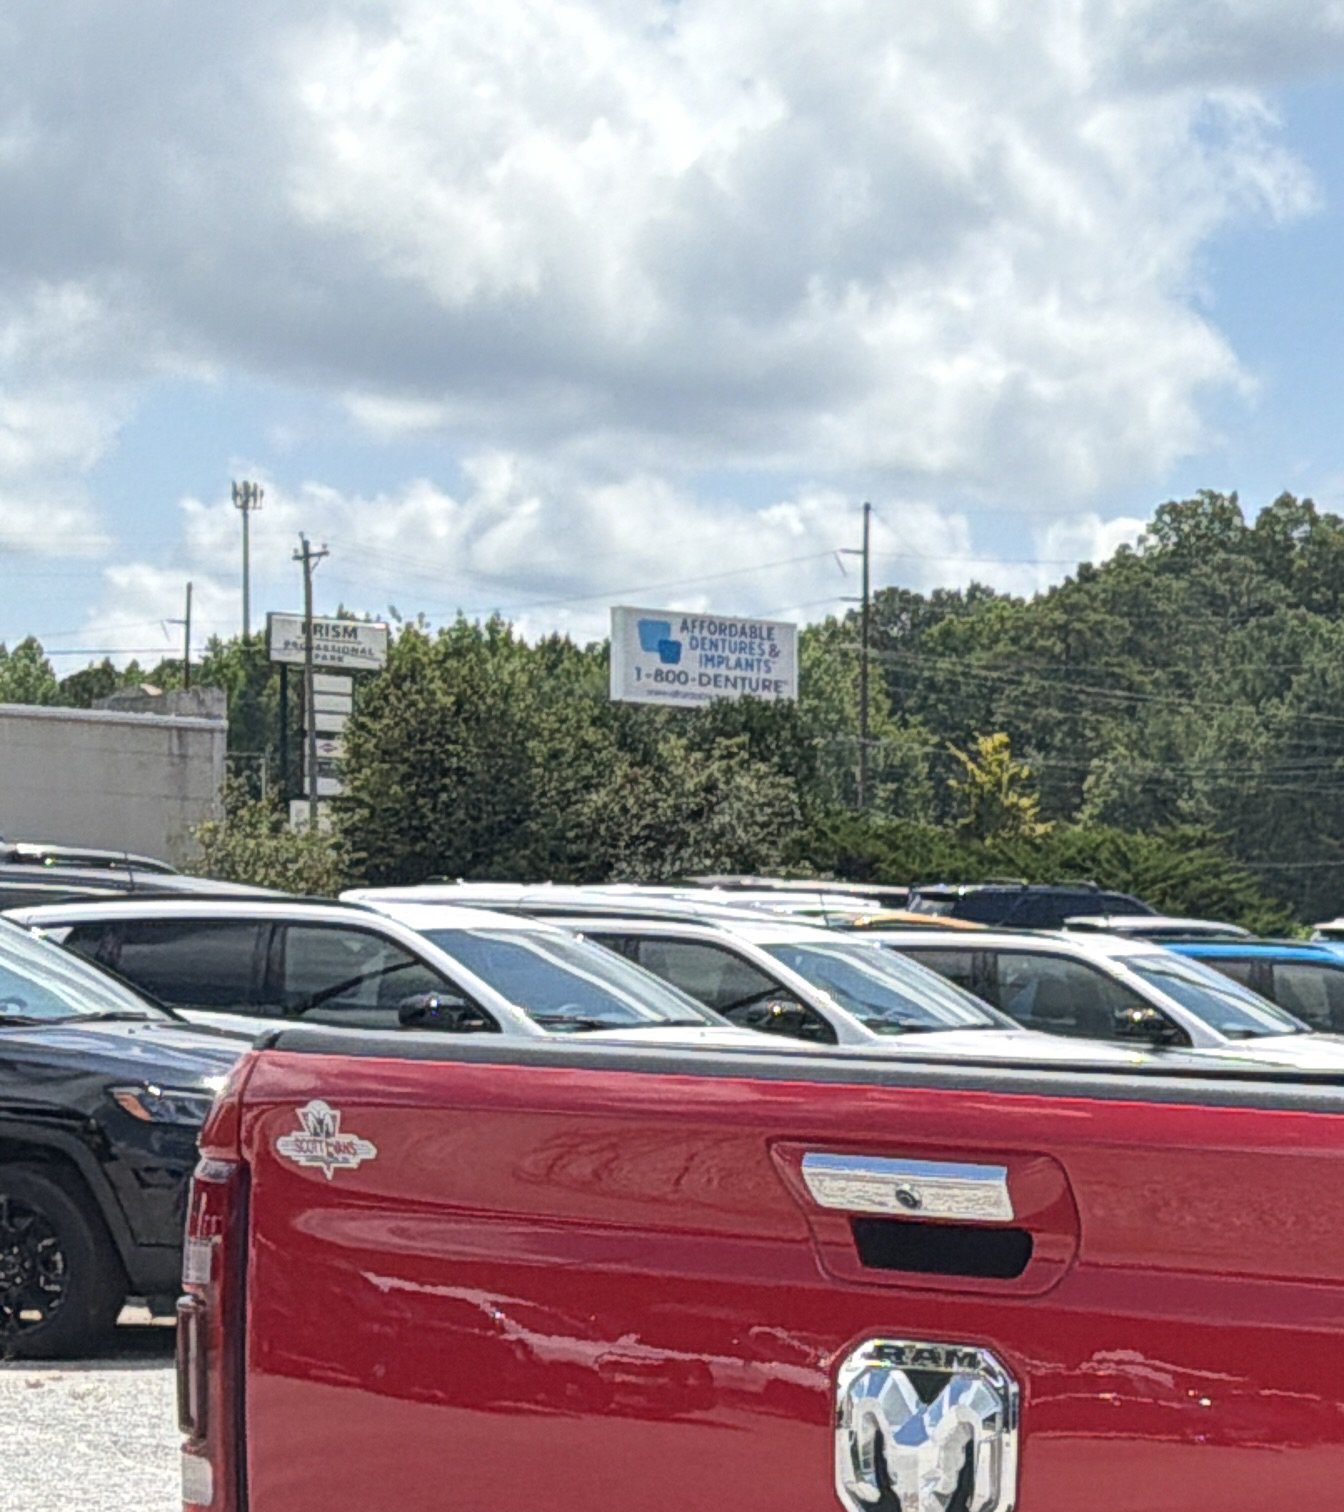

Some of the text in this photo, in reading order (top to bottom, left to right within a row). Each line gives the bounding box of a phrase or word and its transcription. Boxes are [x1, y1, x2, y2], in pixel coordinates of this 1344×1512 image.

[680, 618, 775, 642] AFFORDABLE
[689, 635, 781, 658] DENTURES &
[698, 653, 772, 675] IMPLANTS
[635, 666, 784, 694] 1-800-DENTURE
[868, 1344, 980, 1369] RAM
